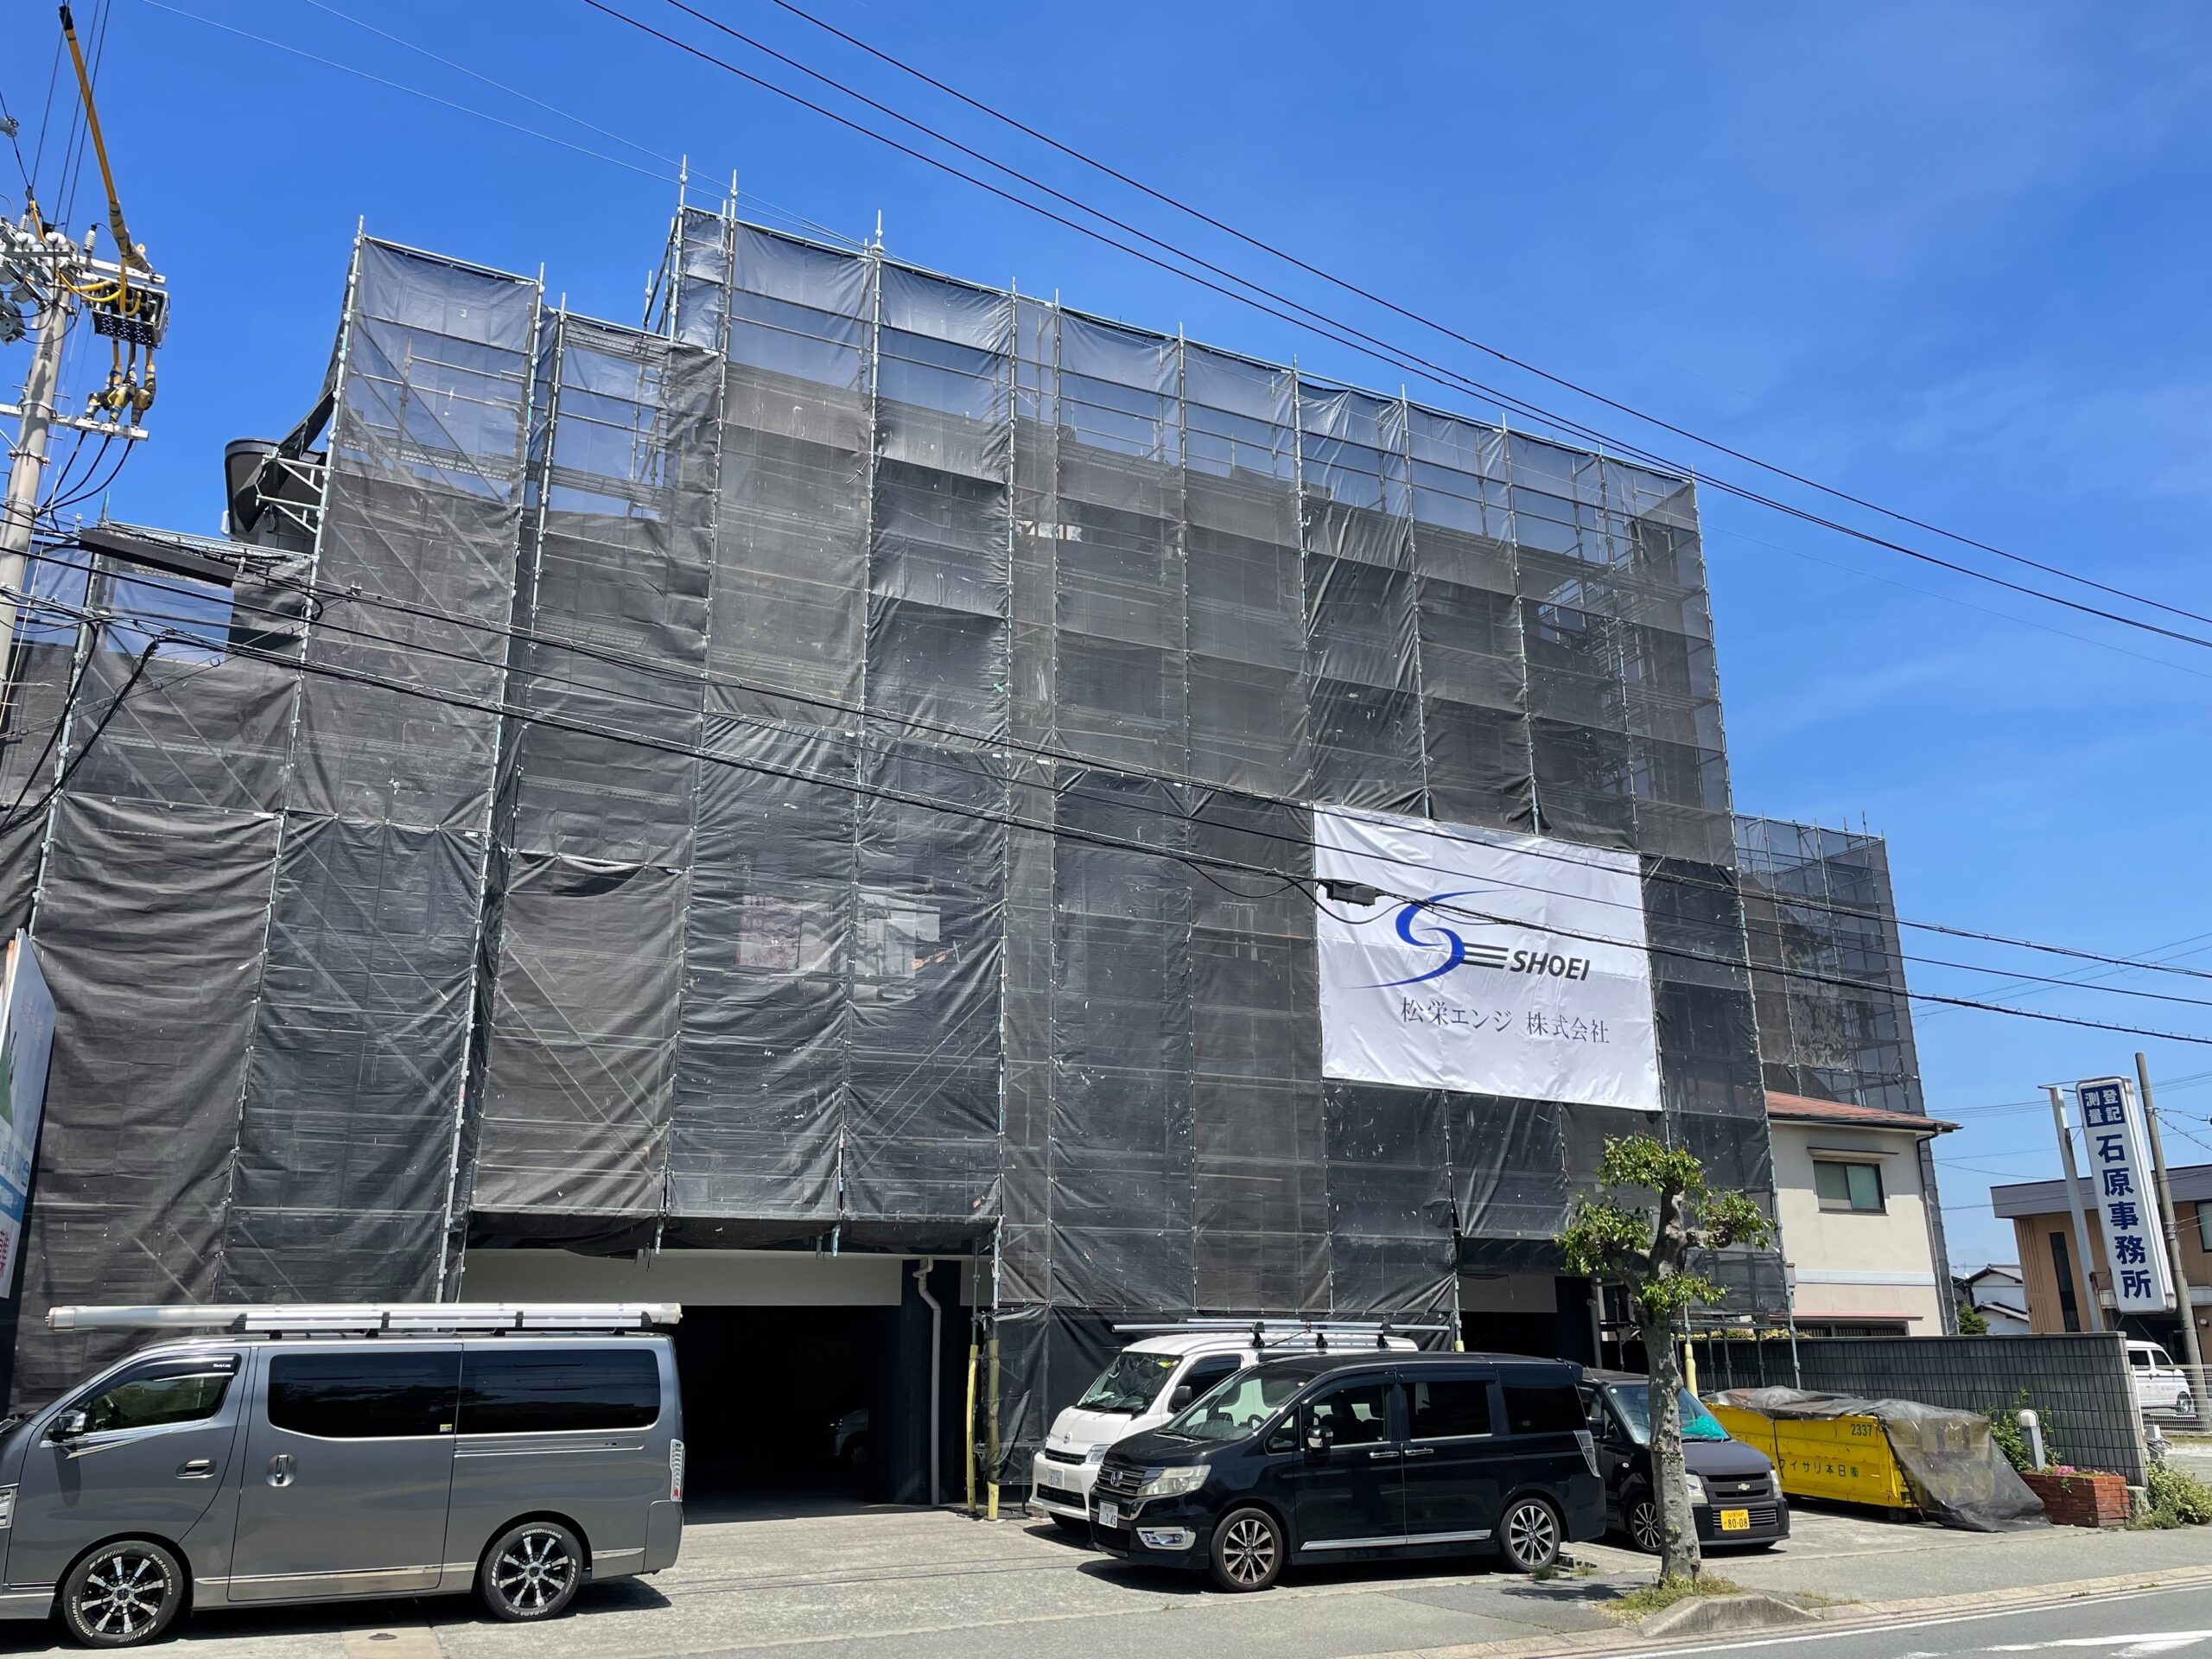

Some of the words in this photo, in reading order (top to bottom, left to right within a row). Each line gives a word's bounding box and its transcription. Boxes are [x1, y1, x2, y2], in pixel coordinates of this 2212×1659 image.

[1510, 950, 1591, 982] SHOEI
[1400, 997, 1512, 1032] 松栄エンジ
[1526, 1011, 1610, 1044] 株式会社
[2085, 1090, 2104, 1123] 測量
[2102, 1089, 2122, 1122] 登記
[2095, 1134, 2152, 1299] 石原事務所
[1851, 1423, 1872, 1436] 2337
[521, 1528, 563, 1540] YOKOHAMA
[1727, 1517, 1748, 1529] 80-08
[72, 1595, 94, 1638] YOKOHAMA
